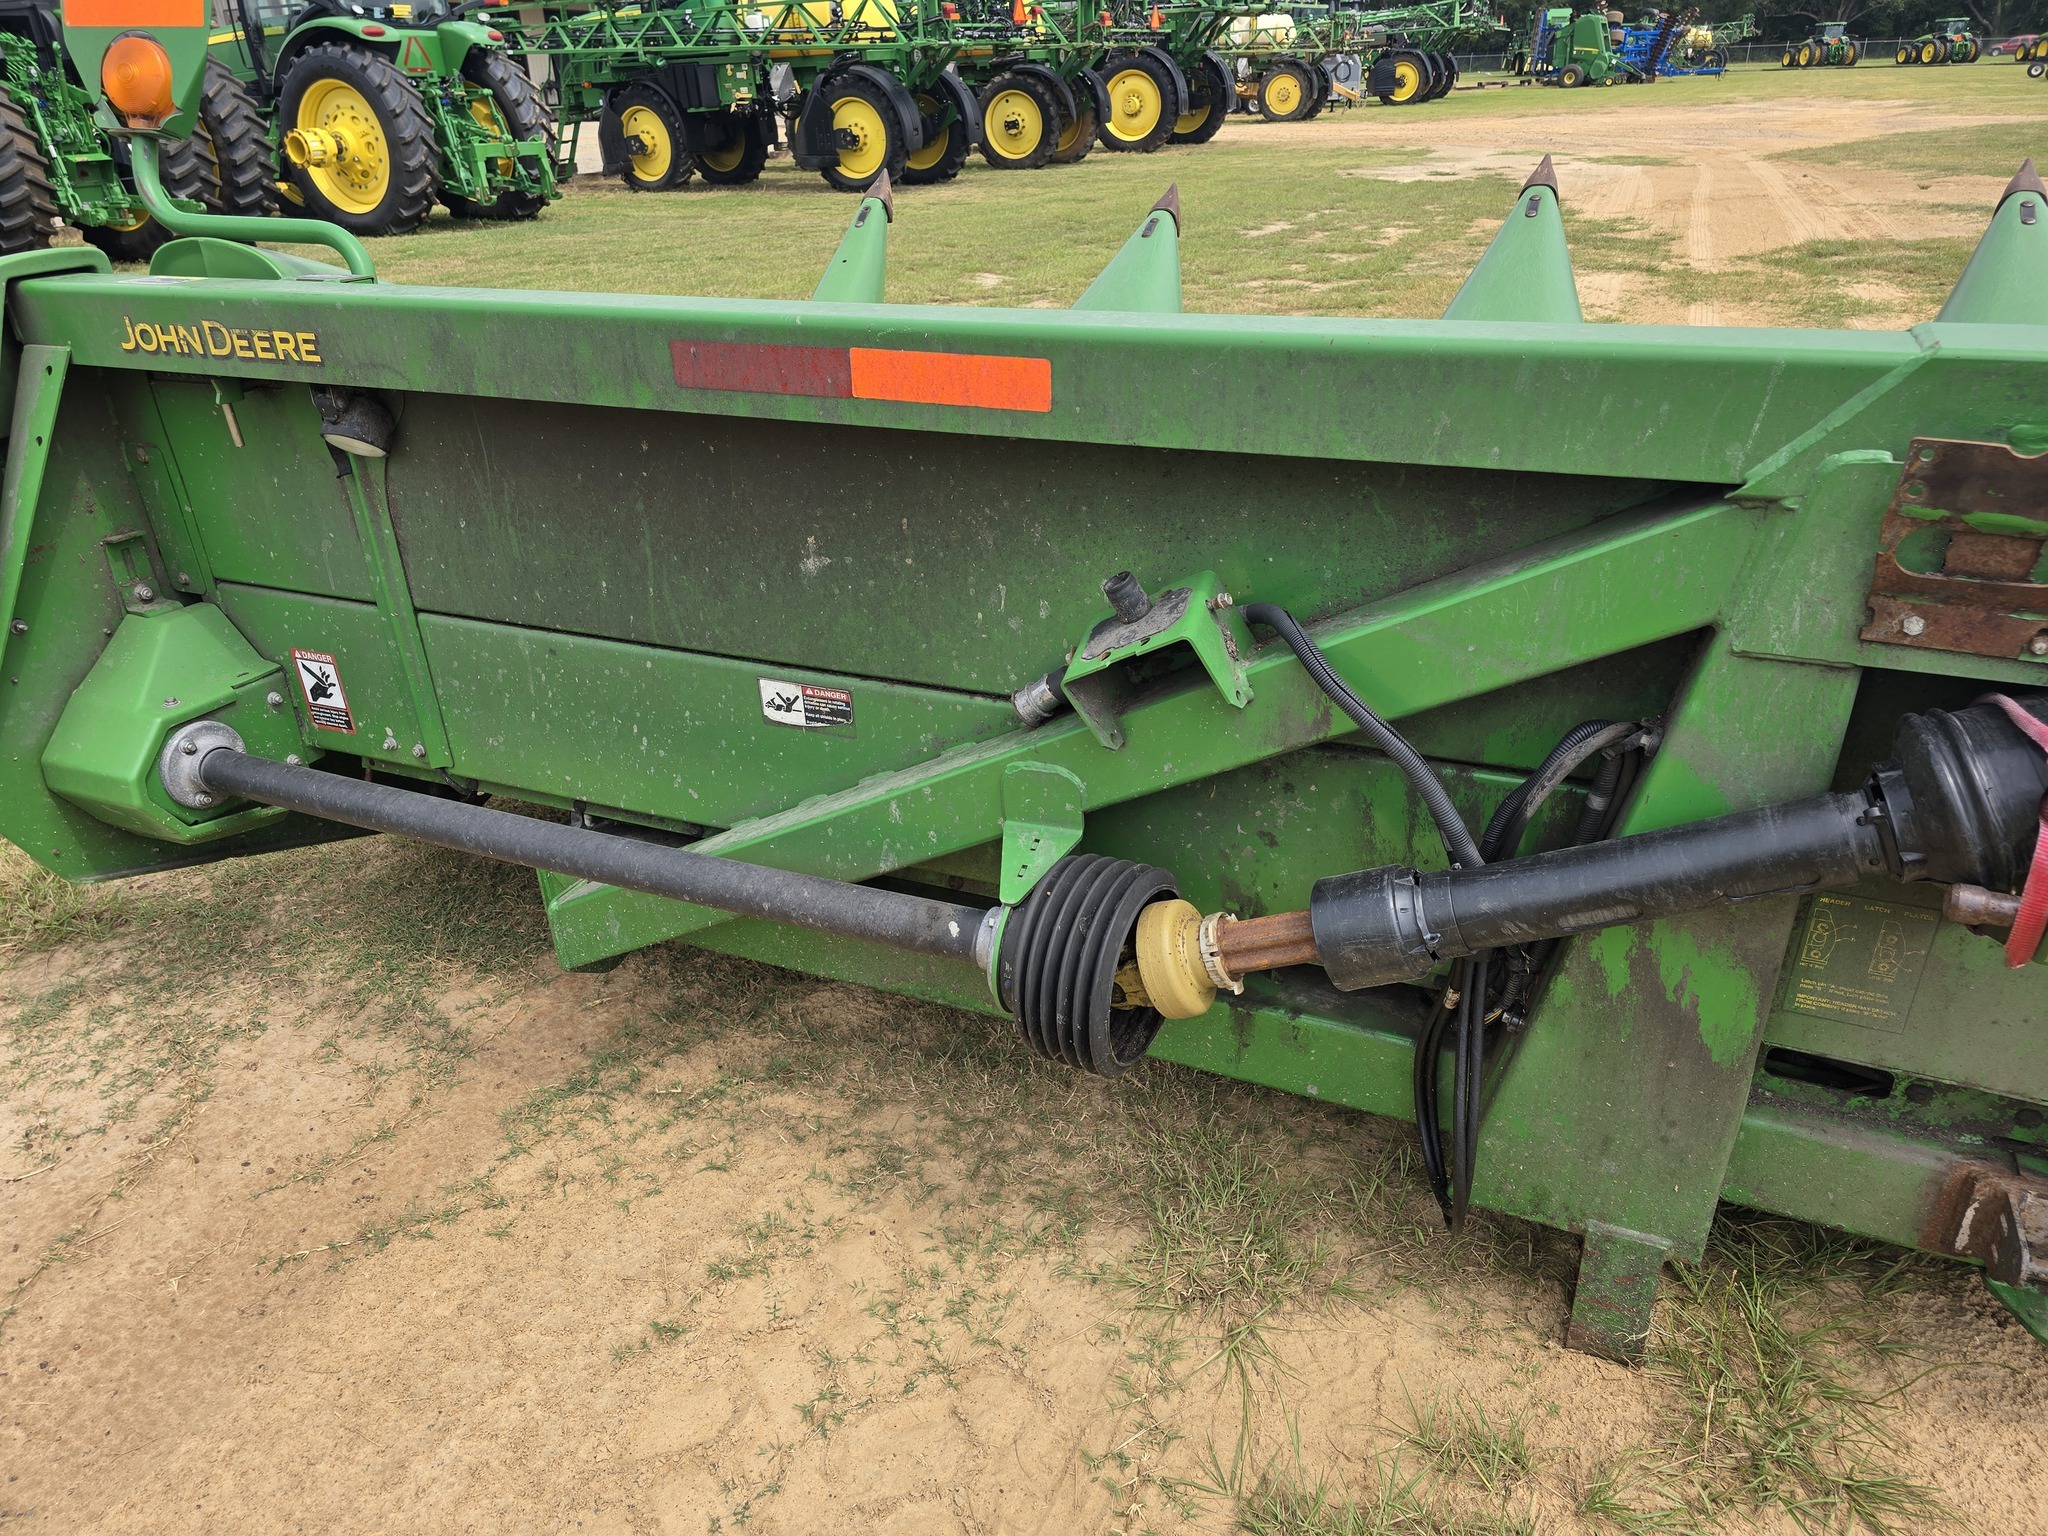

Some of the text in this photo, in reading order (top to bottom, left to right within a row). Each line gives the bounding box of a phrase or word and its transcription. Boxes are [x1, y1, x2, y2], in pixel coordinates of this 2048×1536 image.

[121, 315, 322, 363] JOHN DEERE
[301, 651, 333, 663] DANGER
[814, 689, 847, 700] DANGER
[1820, 896, 1852, 907] HEADER
[1864, 905, 1891, 914] LATCH
